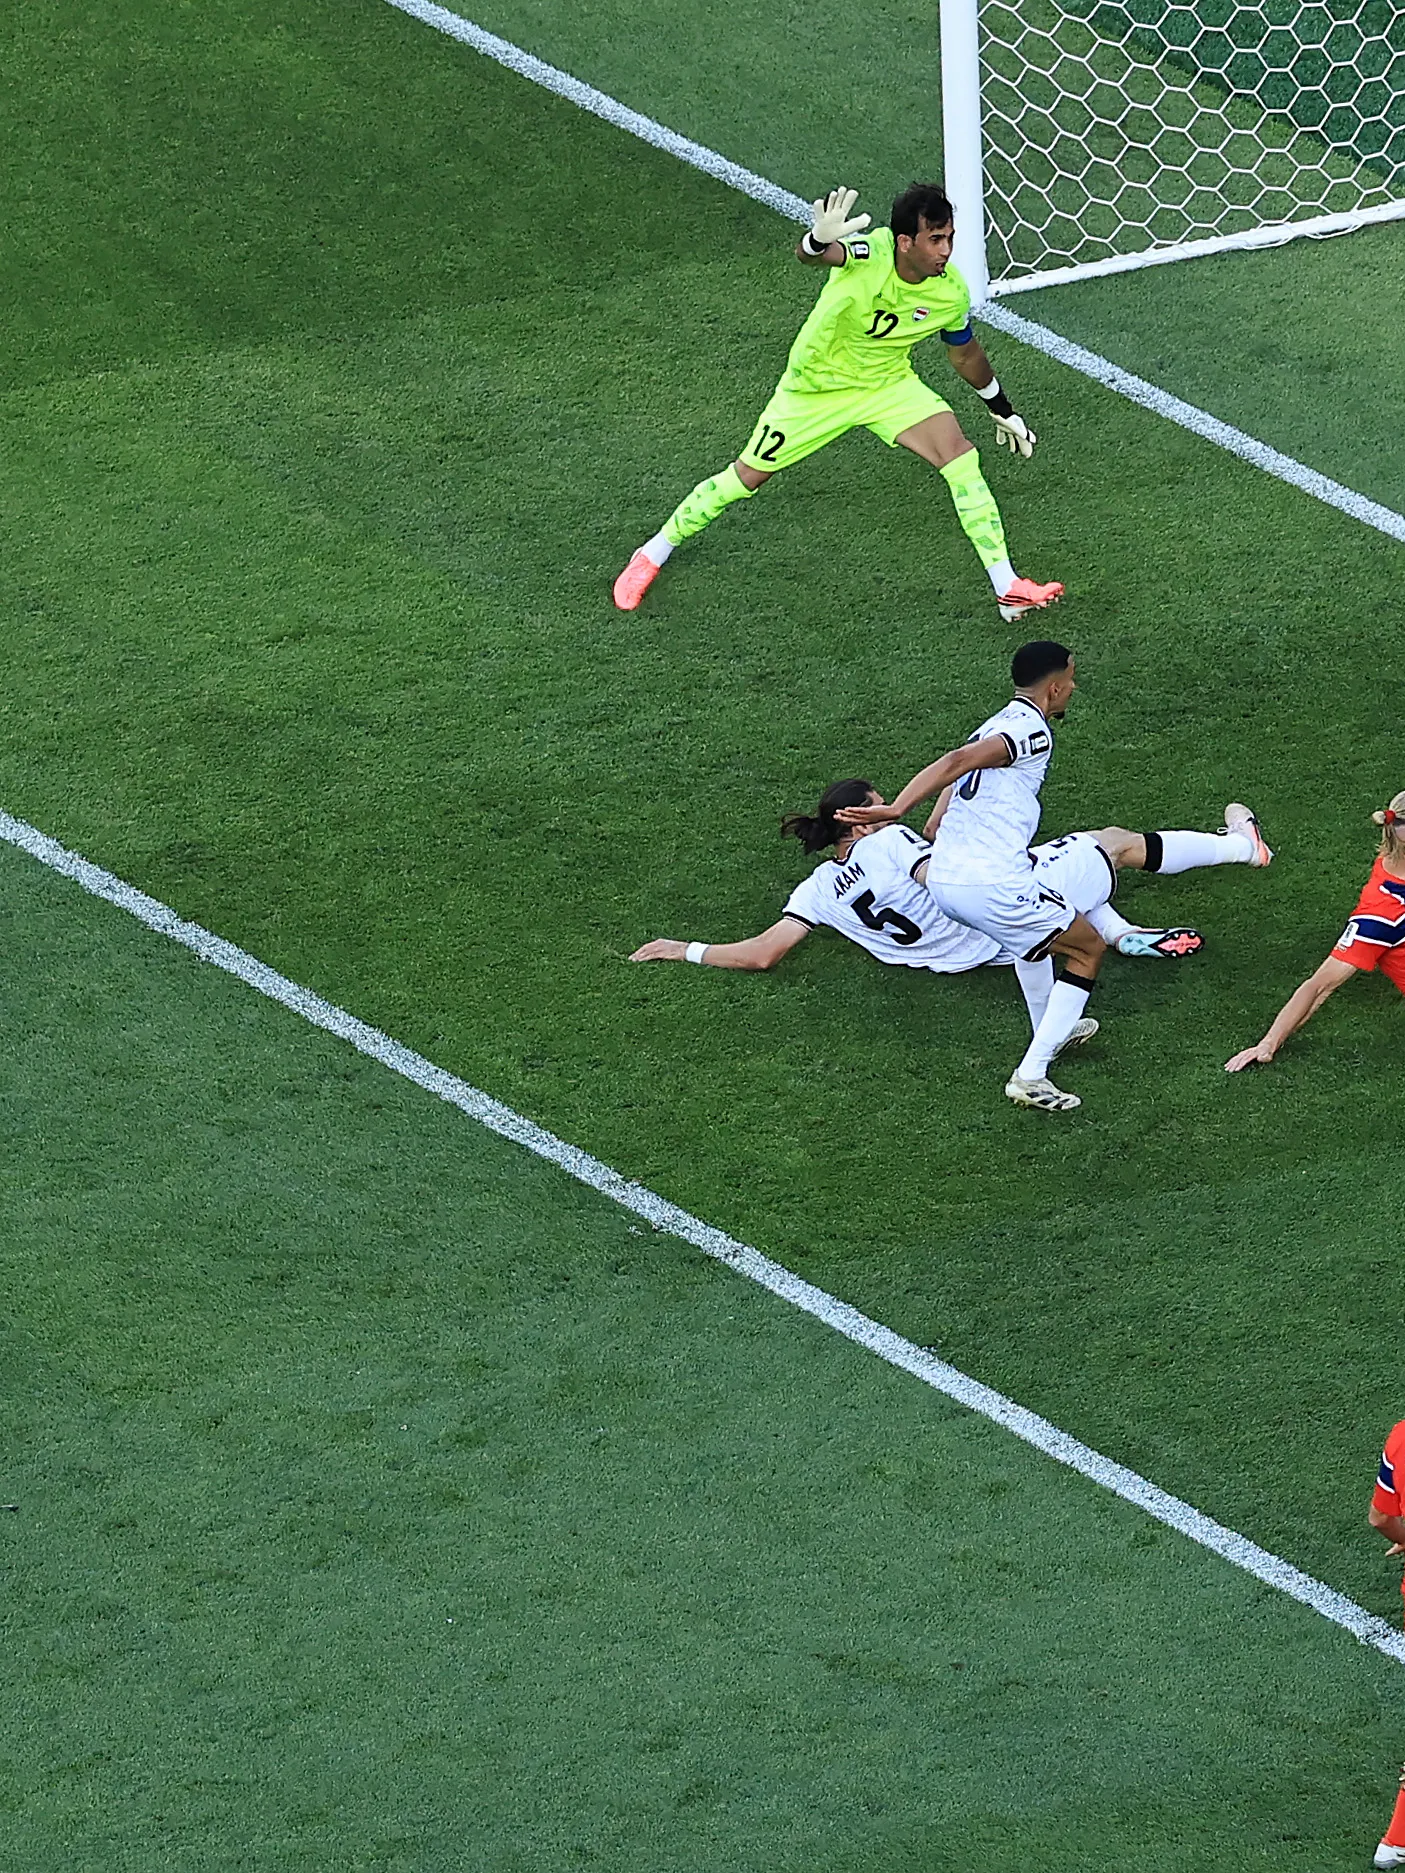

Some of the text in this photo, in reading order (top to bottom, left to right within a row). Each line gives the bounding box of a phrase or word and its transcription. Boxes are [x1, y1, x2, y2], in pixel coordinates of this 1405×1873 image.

[864, 309, 899, 339] 12
[753, 424, 786, 462] 12
[833, 862, 866, 900] AKAM
[850, 888, 922, 945] 5
